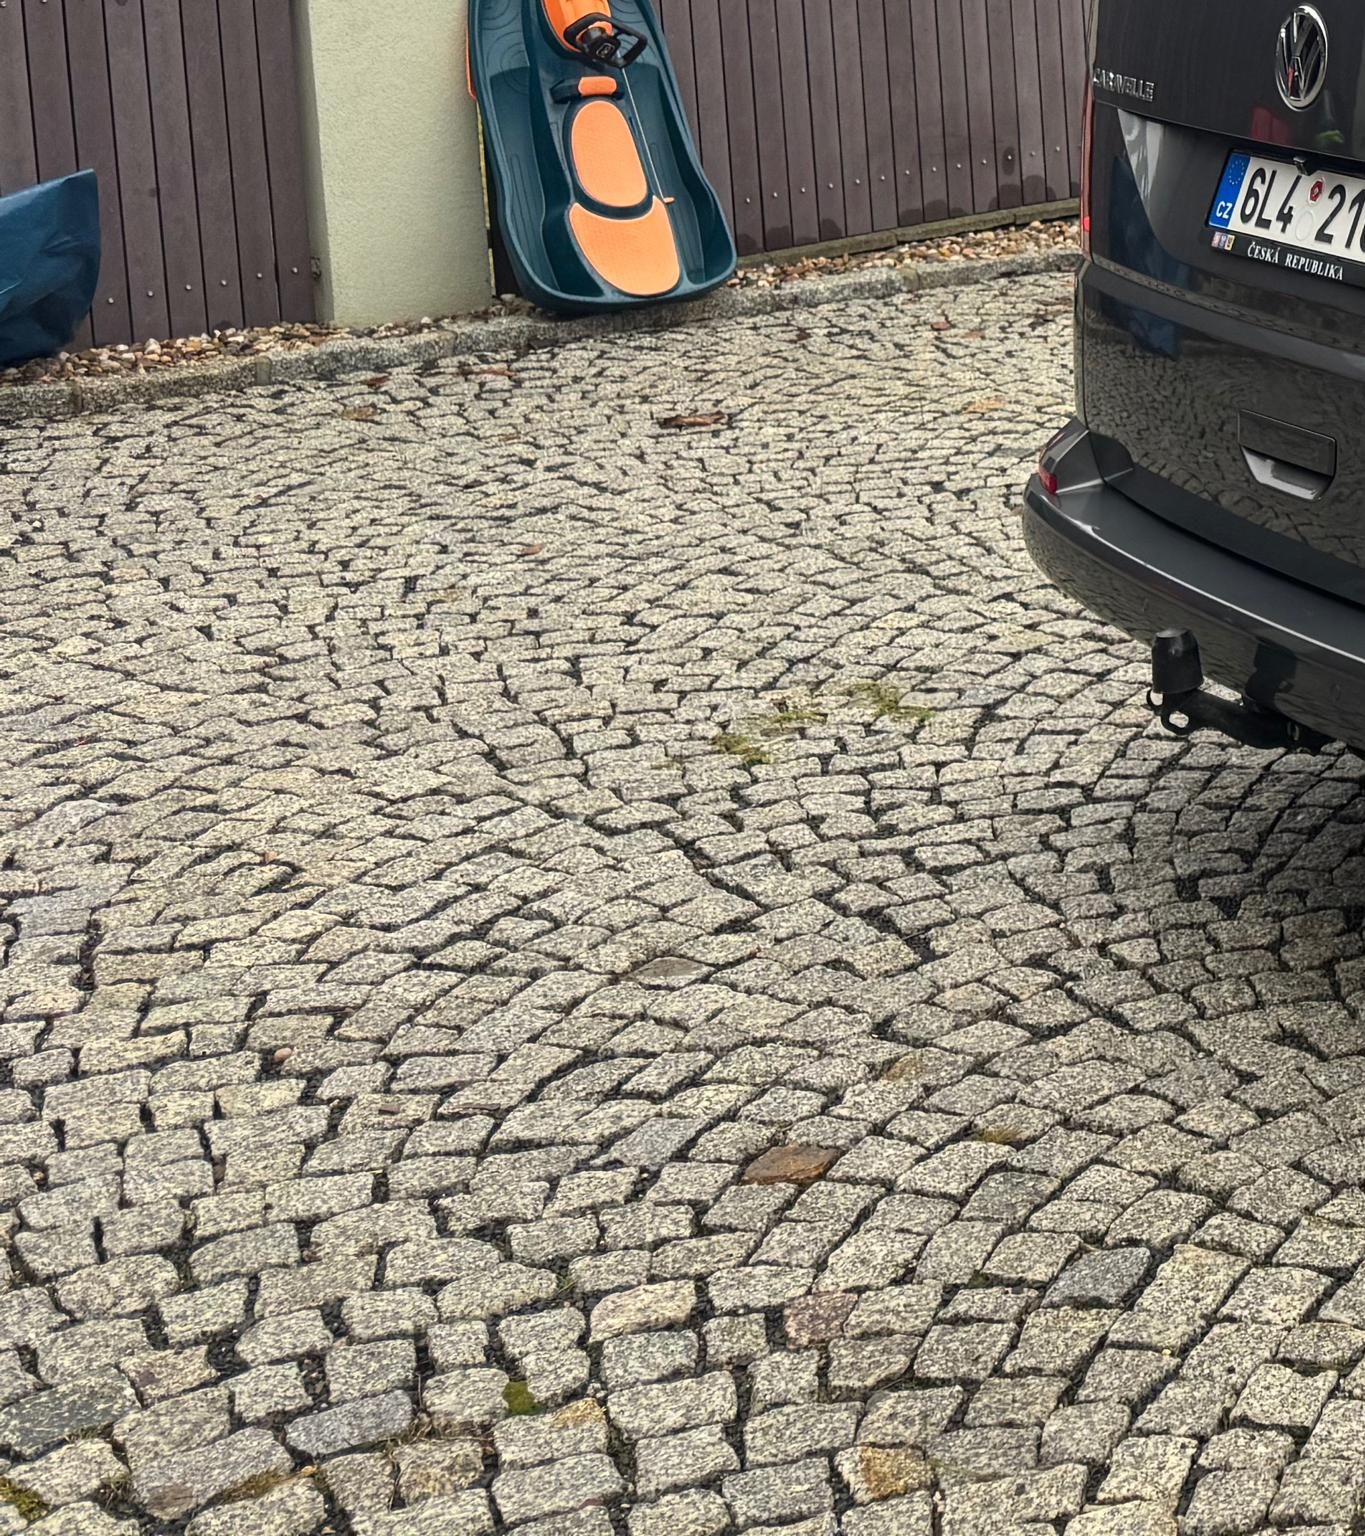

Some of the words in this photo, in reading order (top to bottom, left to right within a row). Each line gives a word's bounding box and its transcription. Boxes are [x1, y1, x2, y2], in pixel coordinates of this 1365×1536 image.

[1093, 68, 1154, 102] CARAVELLE
[1216, 200, 1232, 219] CZ
[1240, 167, 1302, 233] 6L4
[1248, 241, 1280, 264] ČESKÁ
[1285, 253, 1343, 280] REPUBLIKA
